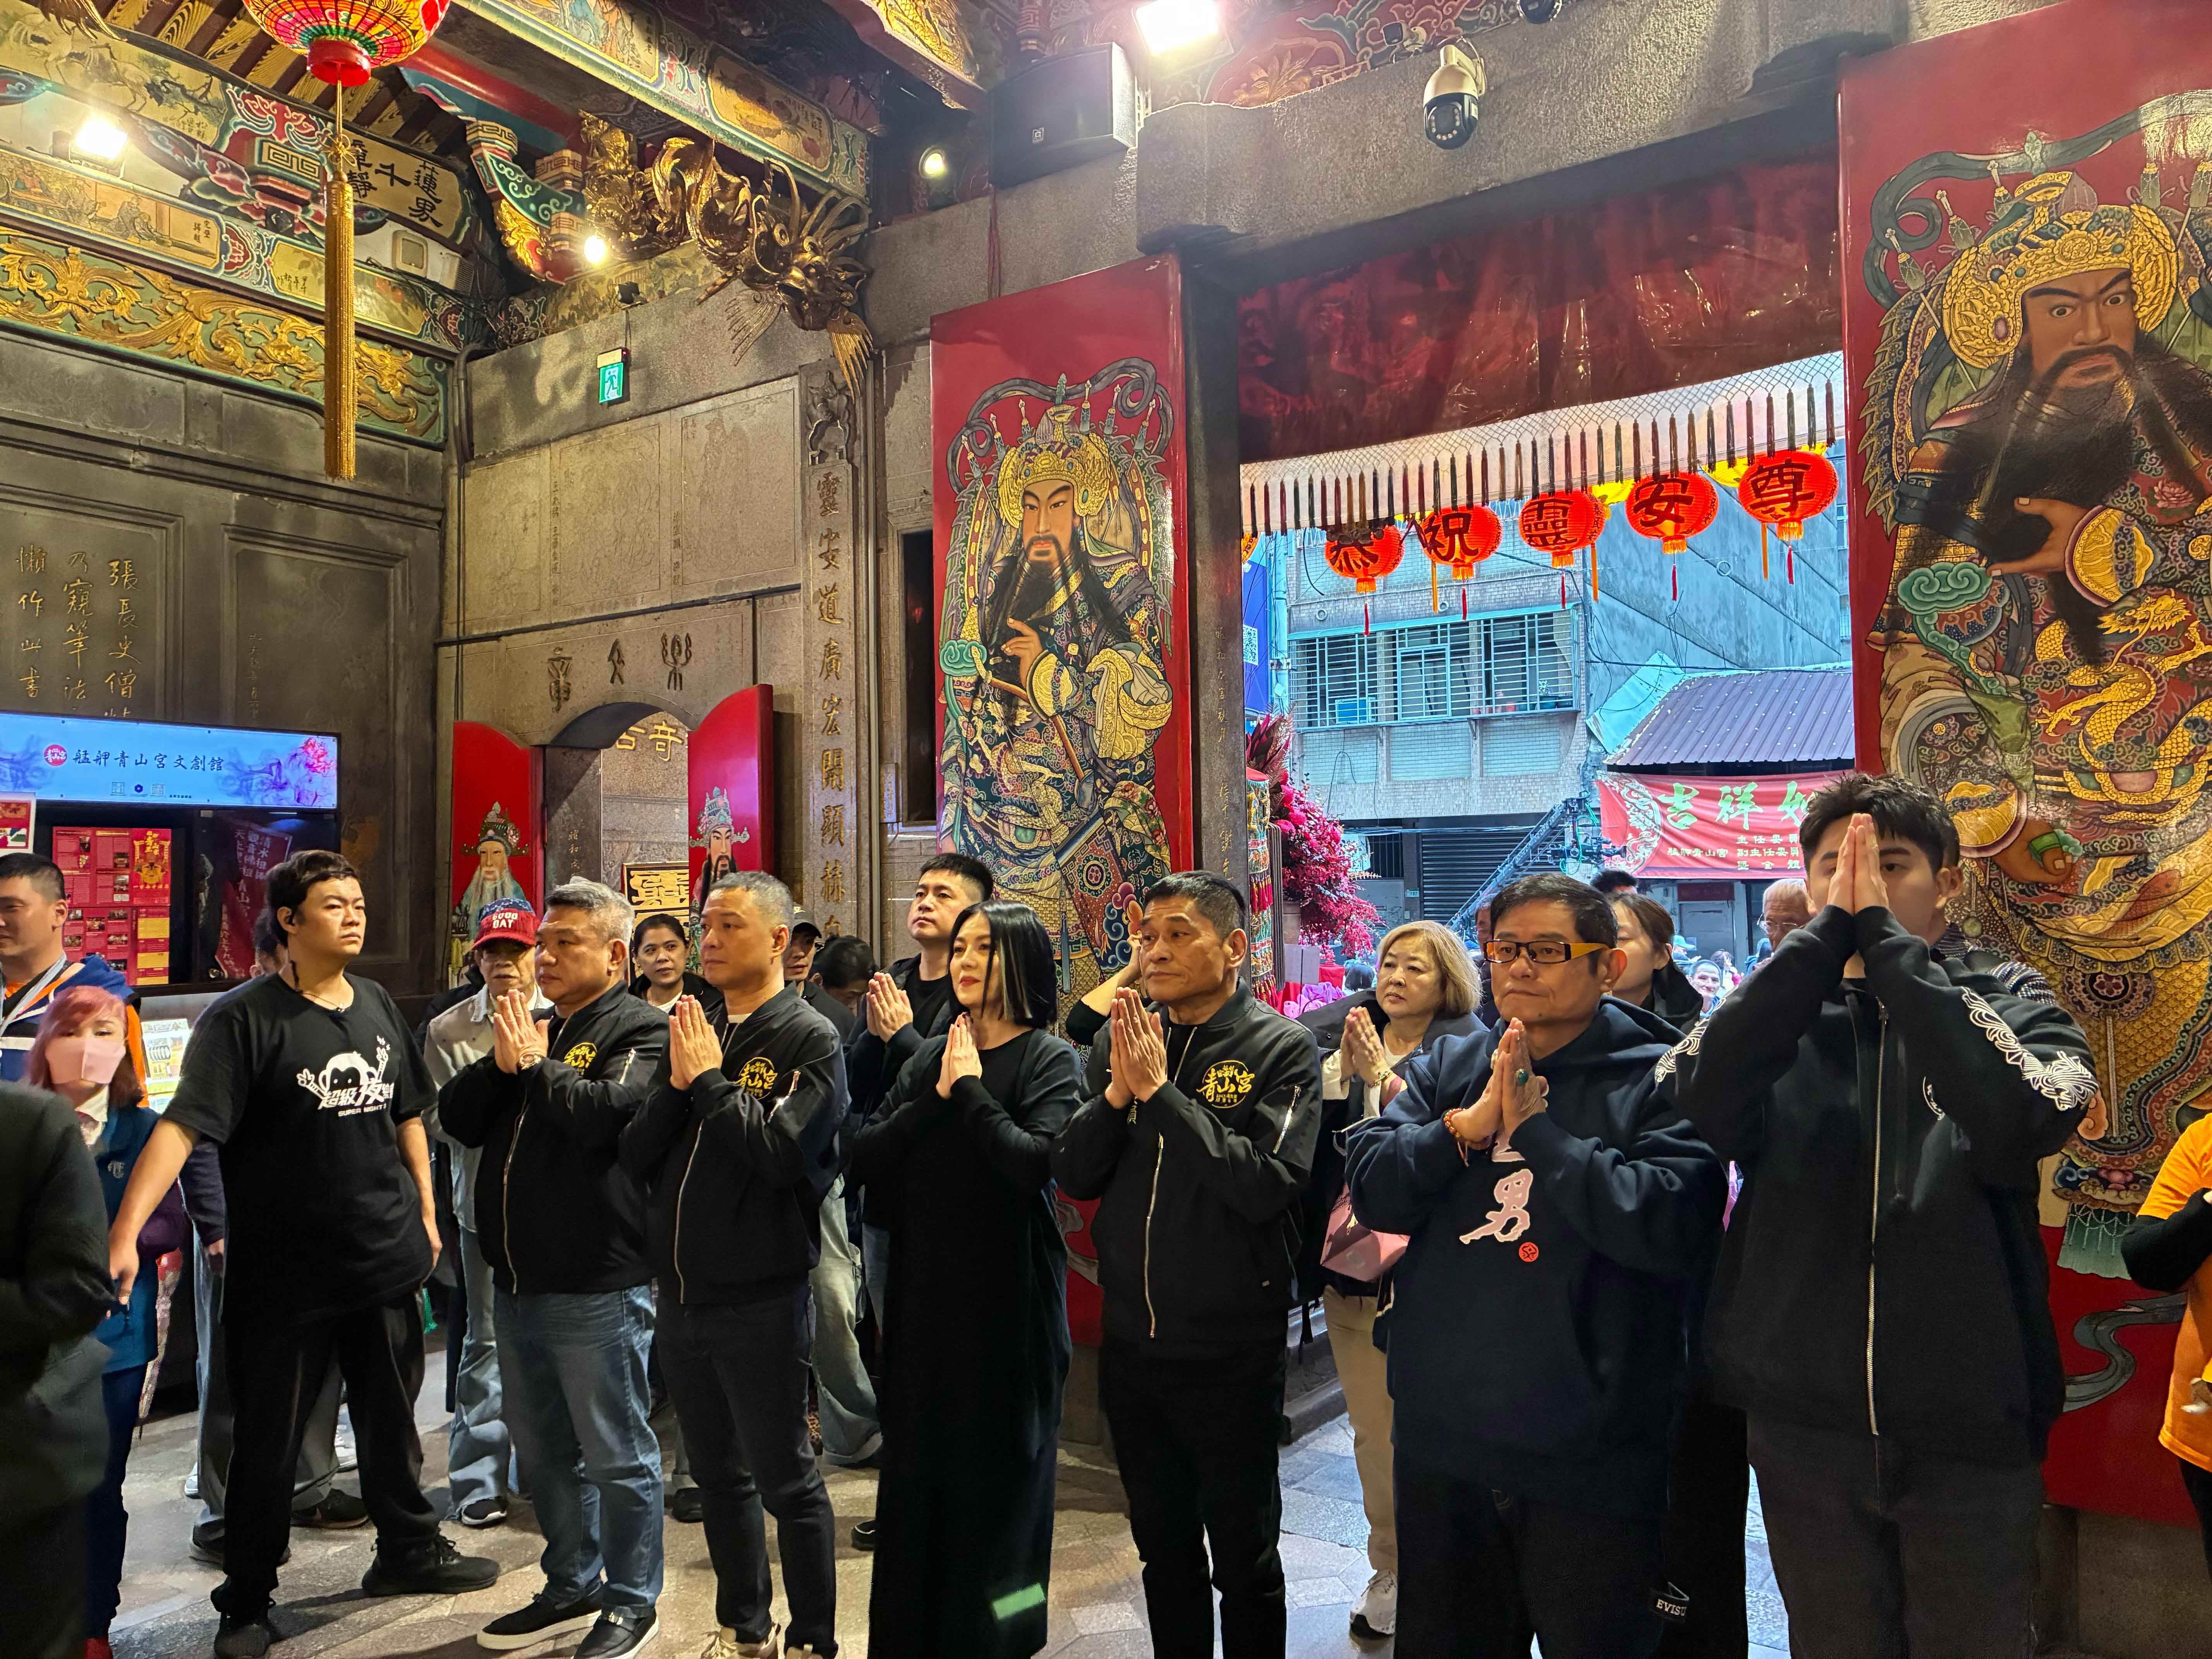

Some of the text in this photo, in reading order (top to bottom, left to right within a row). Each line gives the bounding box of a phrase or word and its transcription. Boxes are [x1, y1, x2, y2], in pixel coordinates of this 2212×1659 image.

[1633, 474, 1694, 527] 安
[1746, 458, 1815, 520] 尊
[1423, 512, 1479, 562] 祝
[1522, 498, 1578, 547] 靈
[105, 559, 142, 718] 張長史僧
[72, 749, 224, 771] 艋舺青山宮文創館
[493, 912, 518, 921] GOOD
[493, 919, 514, 929] DAY
[1196, 1068, 1255, 1102] 青山宮
[338, 1108, 361, 1117] SUPER
[1656, 1599, 1687, 1616] EVISU
